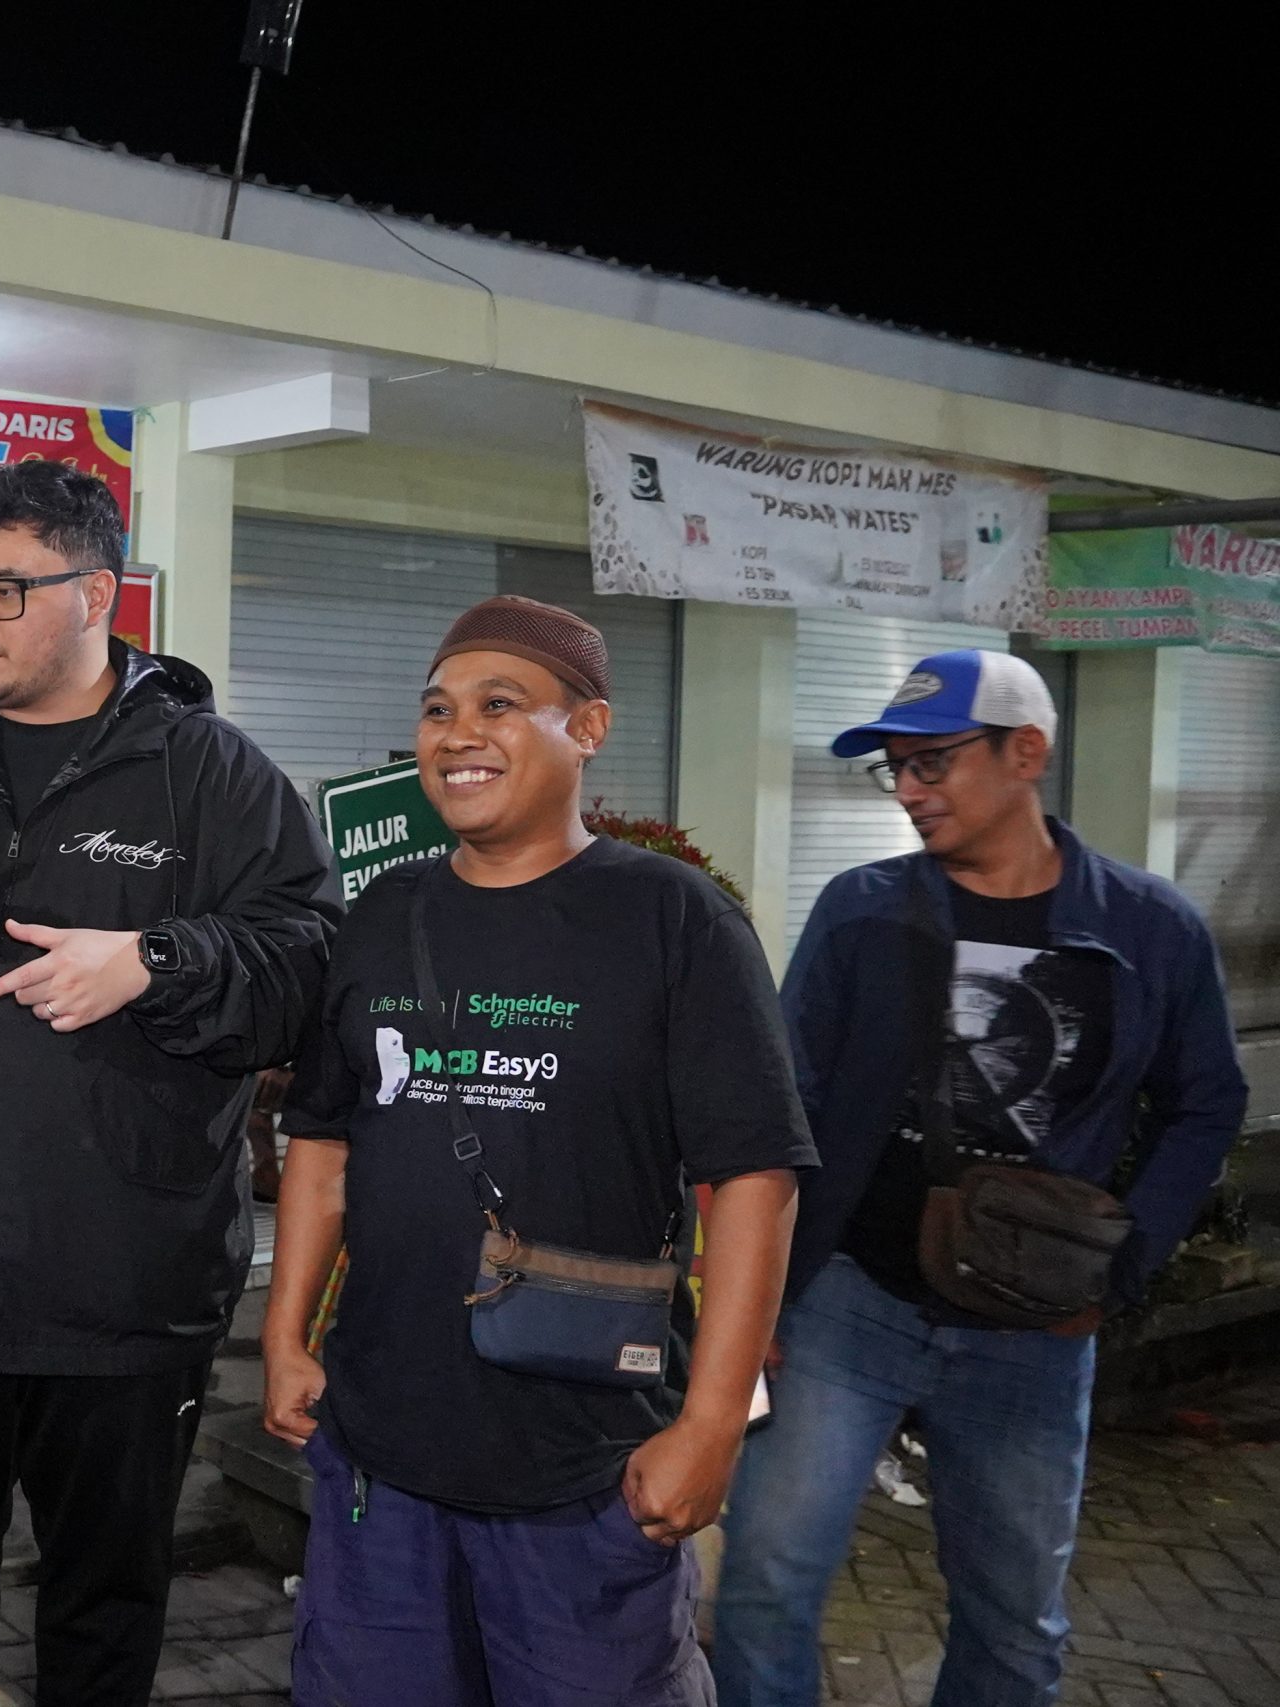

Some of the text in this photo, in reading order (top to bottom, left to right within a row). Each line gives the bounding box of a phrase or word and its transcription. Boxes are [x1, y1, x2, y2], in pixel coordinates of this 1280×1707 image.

[696, 442, 805, 481] WARUNG
[808, 459, 861, 487] KOPI
[916, 472, 957, 496] MES
[1059, 620, 1112, 639] PECEL
[340, 814, 410, 859] JALUR
[369, 996, 396, 1013] Life
[399, 996, 414, 1011] Is
[468, 993, 580, 1017] Schneider
[508, 1012, 574, 1030] Electric
[414, 1047, 558, 1081] MCB Easy9
[406, 1088, 447, 1103] dengan
[487, 1095, 546, 1113] terpercaya
[410, 1079, 433, 1090] MCB
[463, 1084, 498, 1096] rumah
[500, 1084, 535, 1100] tinggal
